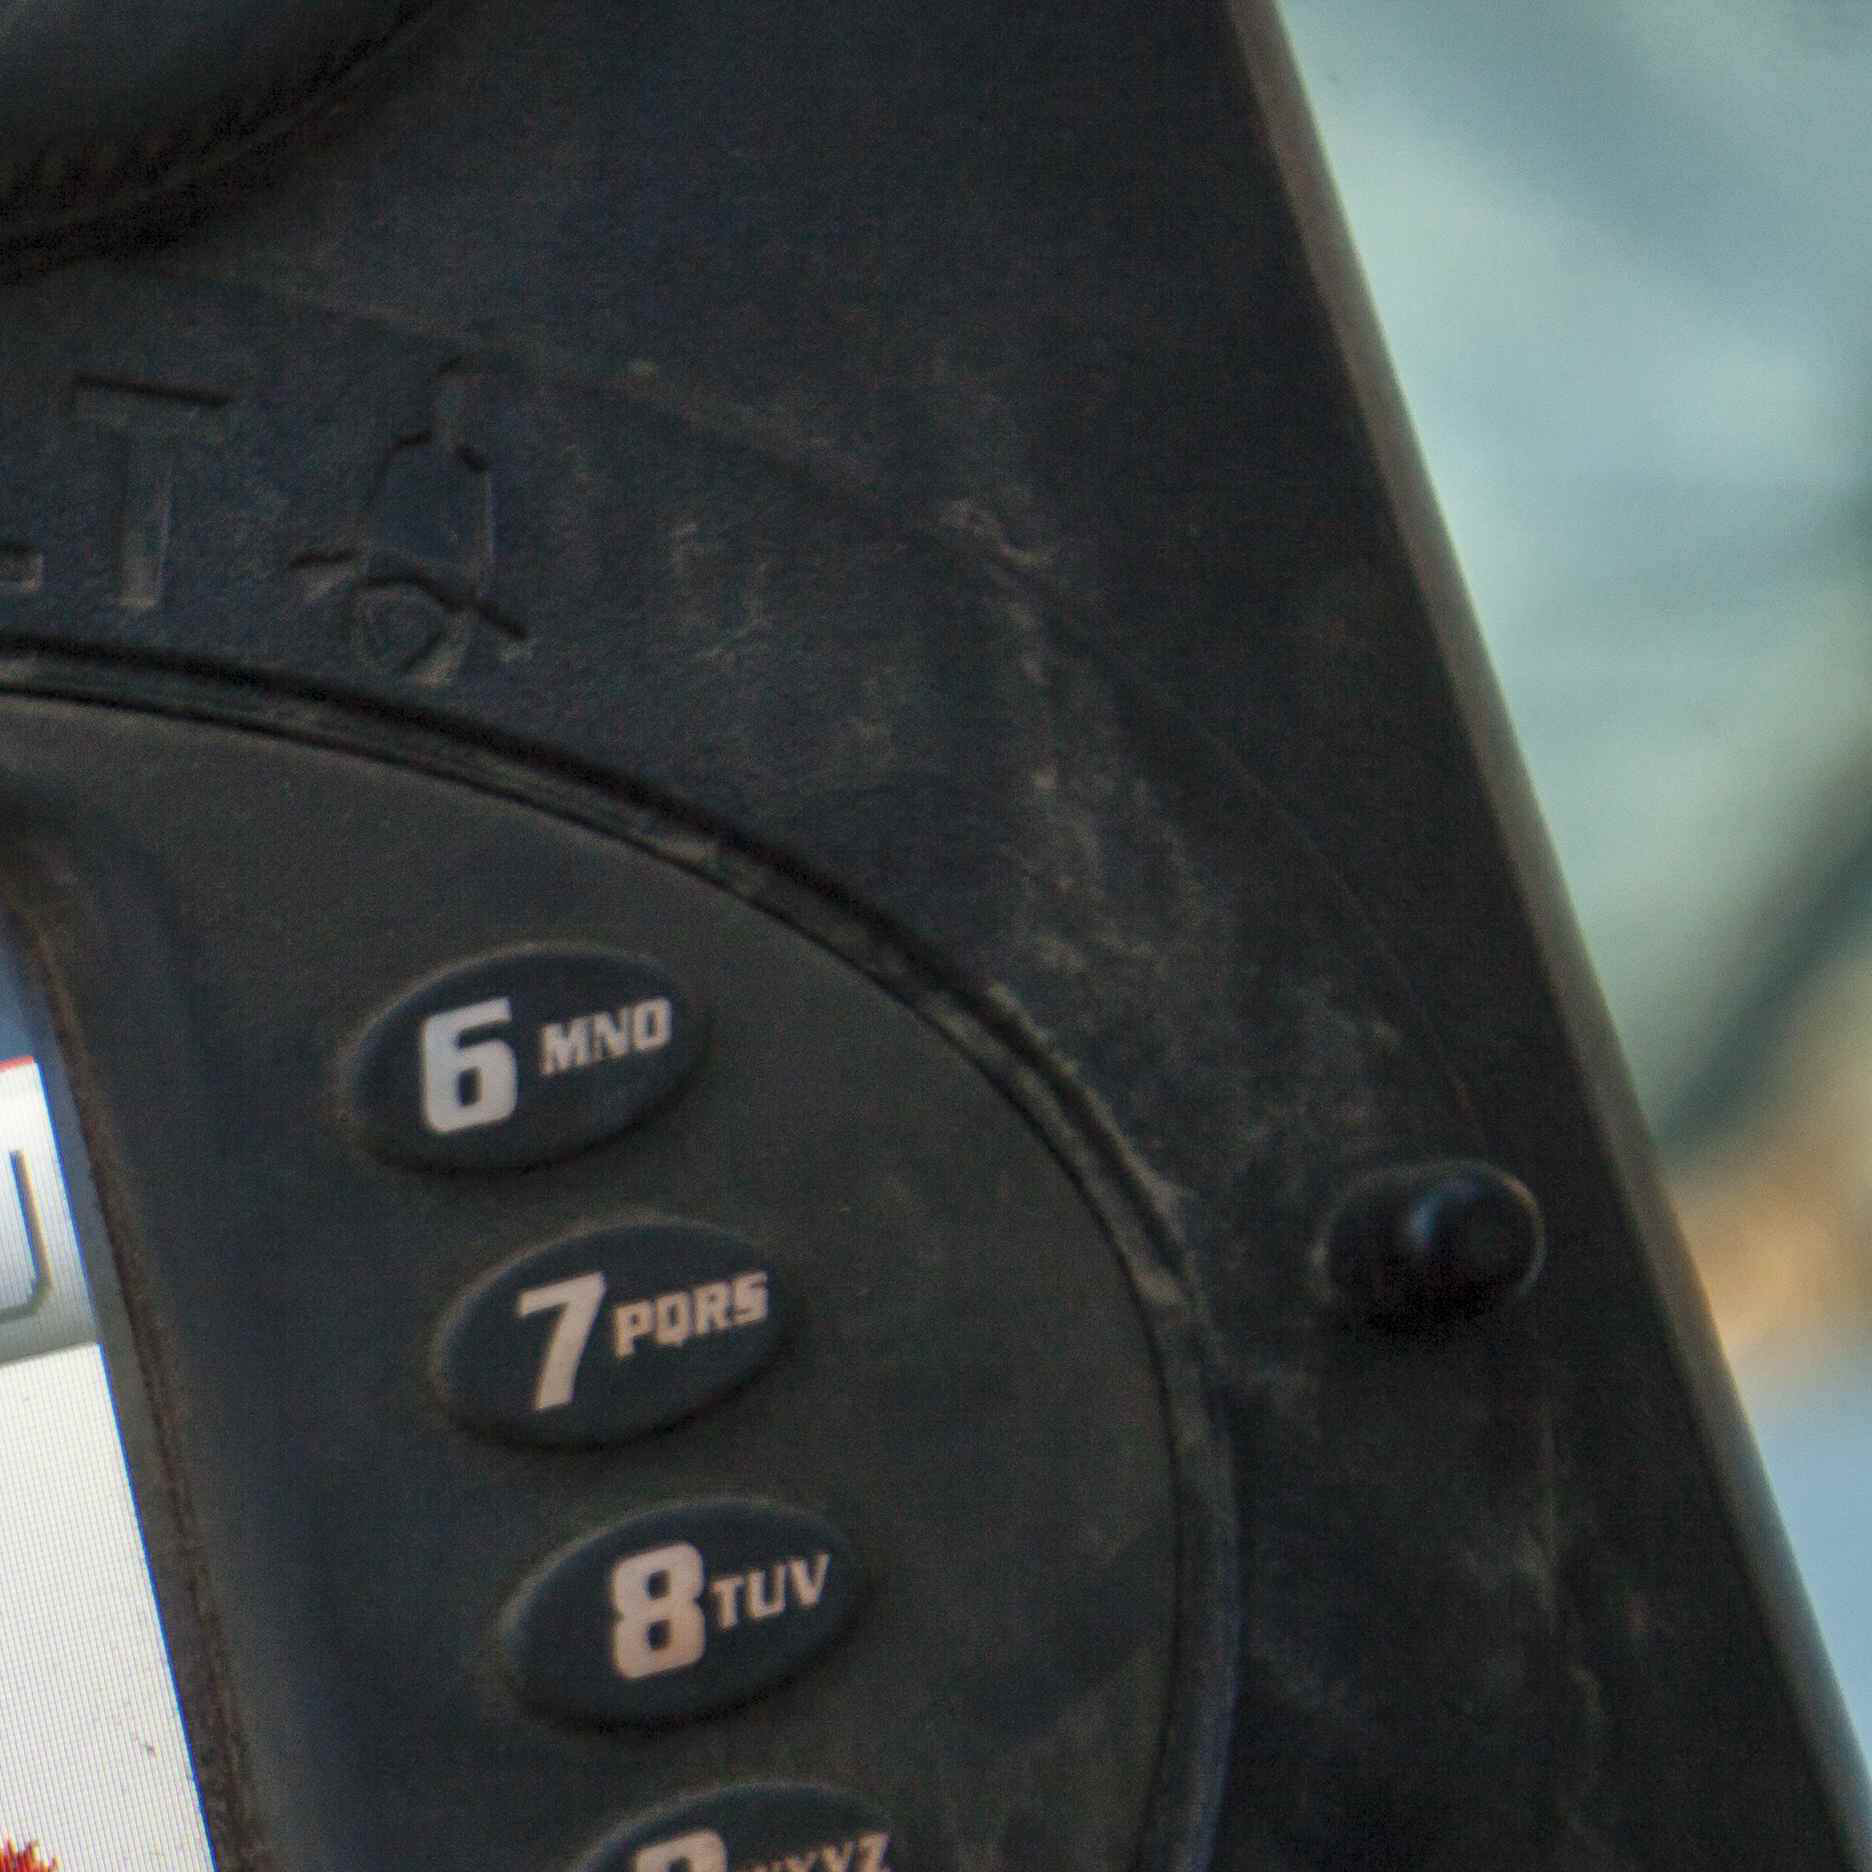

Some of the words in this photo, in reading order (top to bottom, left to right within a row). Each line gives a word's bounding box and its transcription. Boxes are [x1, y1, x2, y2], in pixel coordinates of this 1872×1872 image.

[418, 998, 518, 1136] 6
[538, 998, 673, 1079] MNO
[518, 1273, 607, 1409] 7
[613, 1269, 769, 1355] PQRS
[612, 1541, 706, 1681] 8
[709, 1554, 831, 1631] TUV
